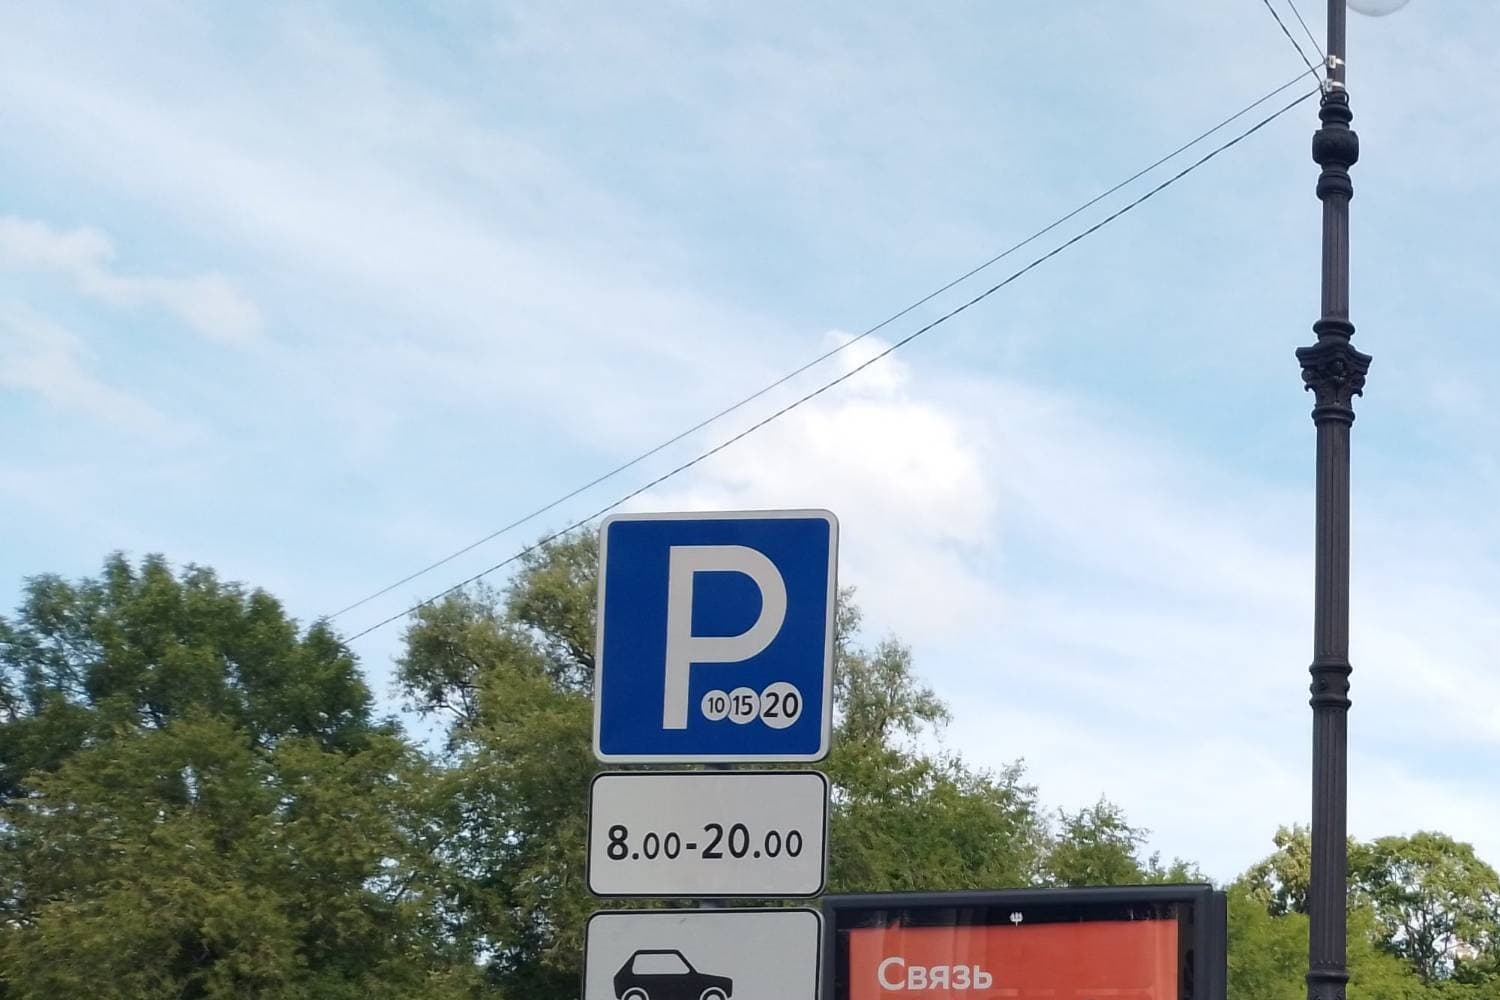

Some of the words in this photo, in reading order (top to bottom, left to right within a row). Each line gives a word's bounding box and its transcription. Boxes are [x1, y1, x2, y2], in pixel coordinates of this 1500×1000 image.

[662, 545, 788, 730] P
[707, 696, 725, 713] 10
[732, 695, 753, 715] 15
[763, 691, 799, 718] 20
[606, 823, 803, 860] 8.00-20.00
[877, 956, 993, 991] Связь
